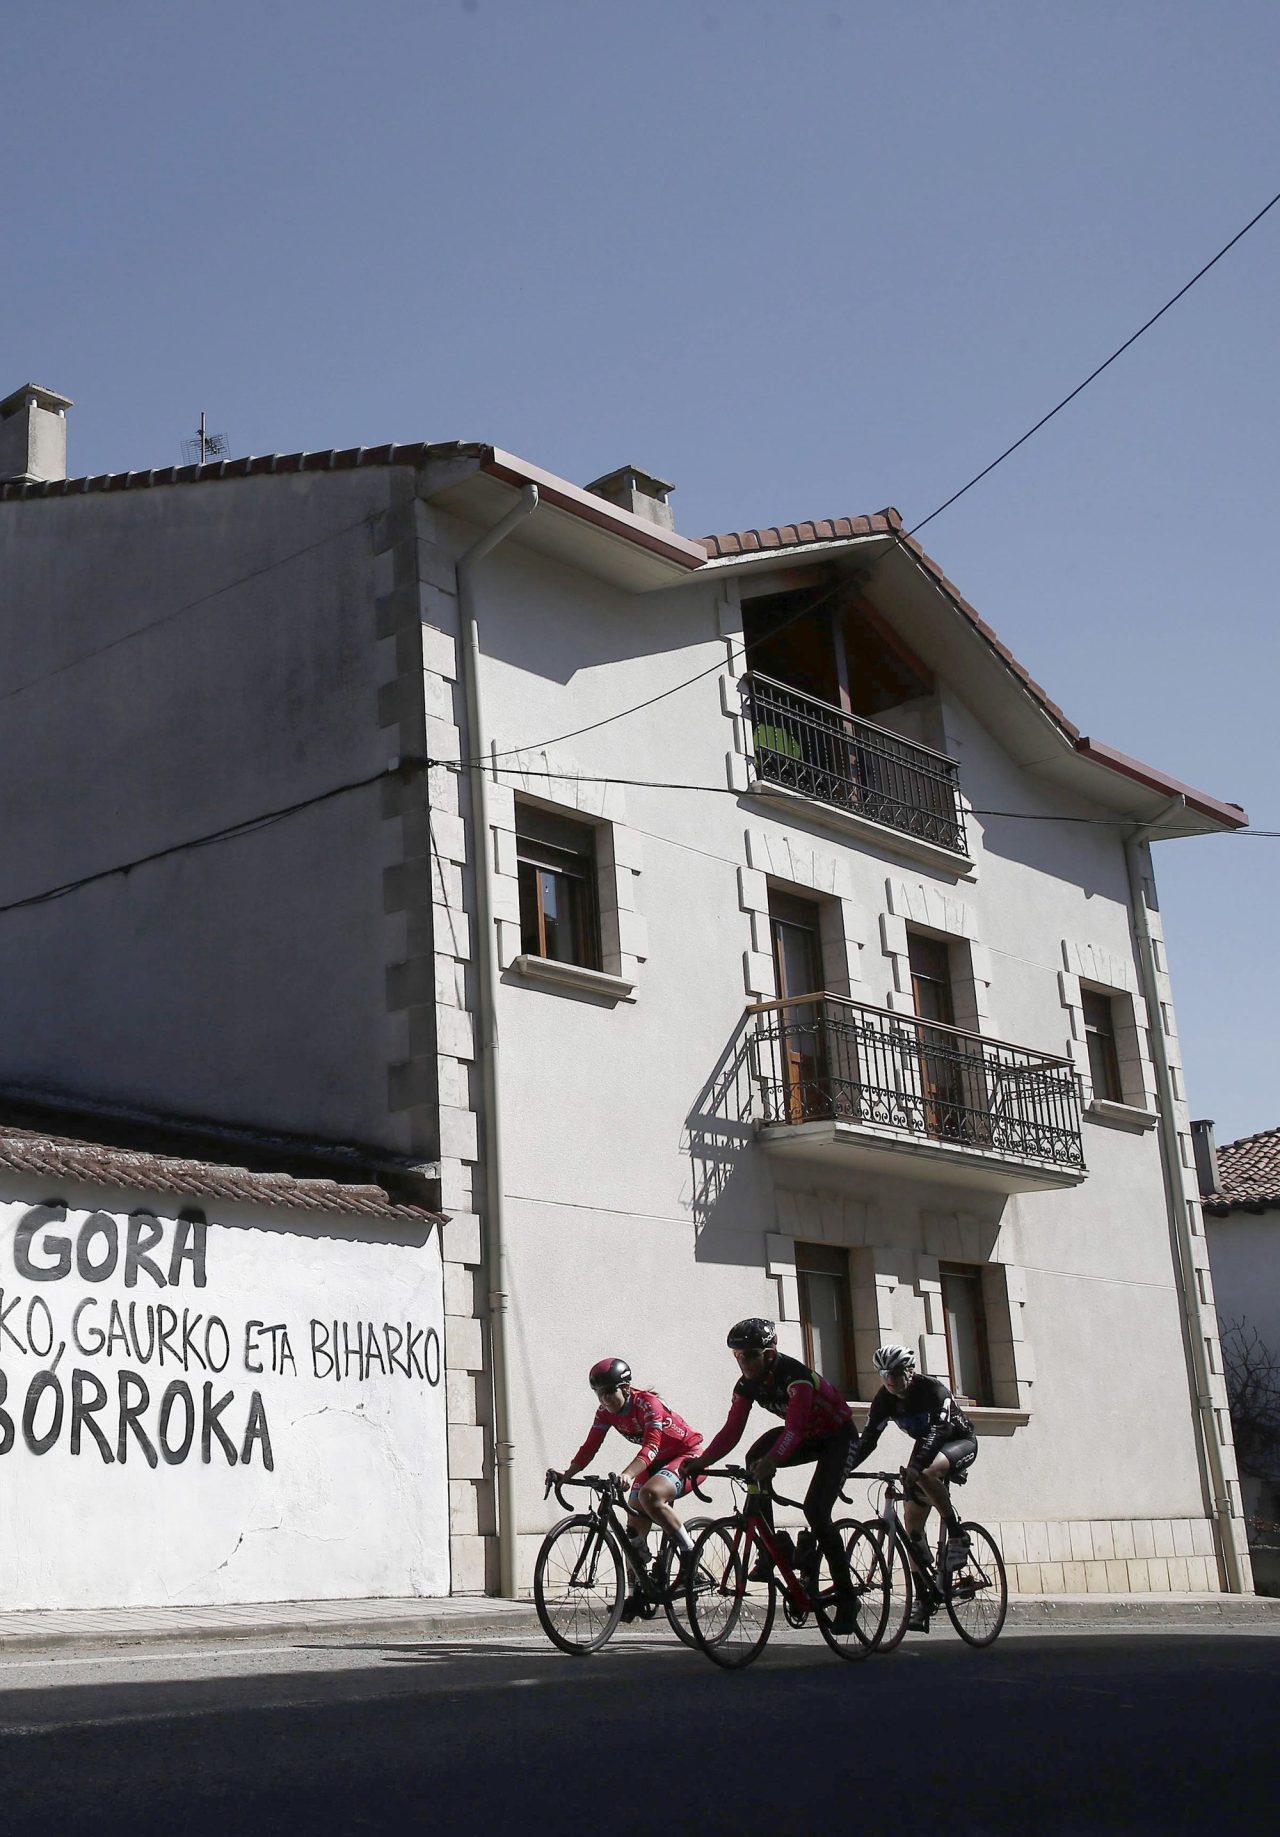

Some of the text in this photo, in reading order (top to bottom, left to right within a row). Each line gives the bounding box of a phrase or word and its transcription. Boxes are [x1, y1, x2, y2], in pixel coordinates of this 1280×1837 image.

[13, 1199, 207, 1288] GORA
[72, 1297, 230, 1373] GAURKO
[244, 1319, 298, 1377] ETA
[310, 1319, 441, 1388] BIHARKO
